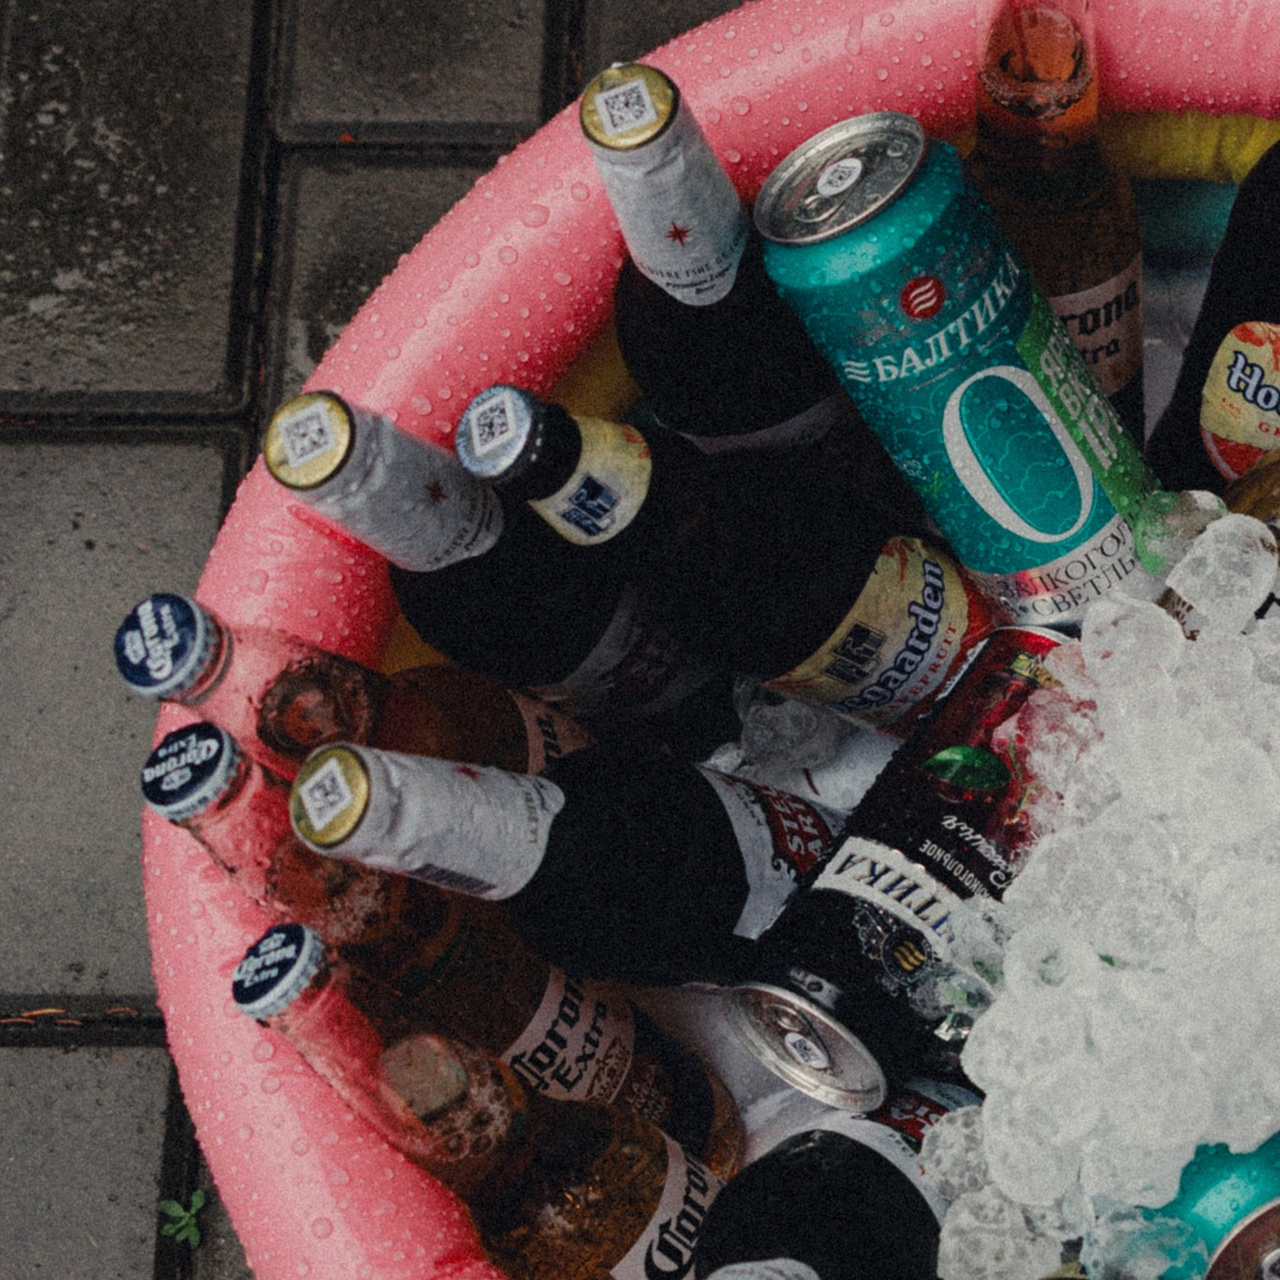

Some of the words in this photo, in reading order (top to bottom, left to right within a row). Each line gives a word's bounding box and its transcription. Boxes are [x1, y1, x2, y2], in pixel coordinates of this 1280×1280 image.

[872, 252, 1021, 383] БАЛТИКА
[143, 738, 220, 783] Corona
[158, 733, 197, 759] Extra
